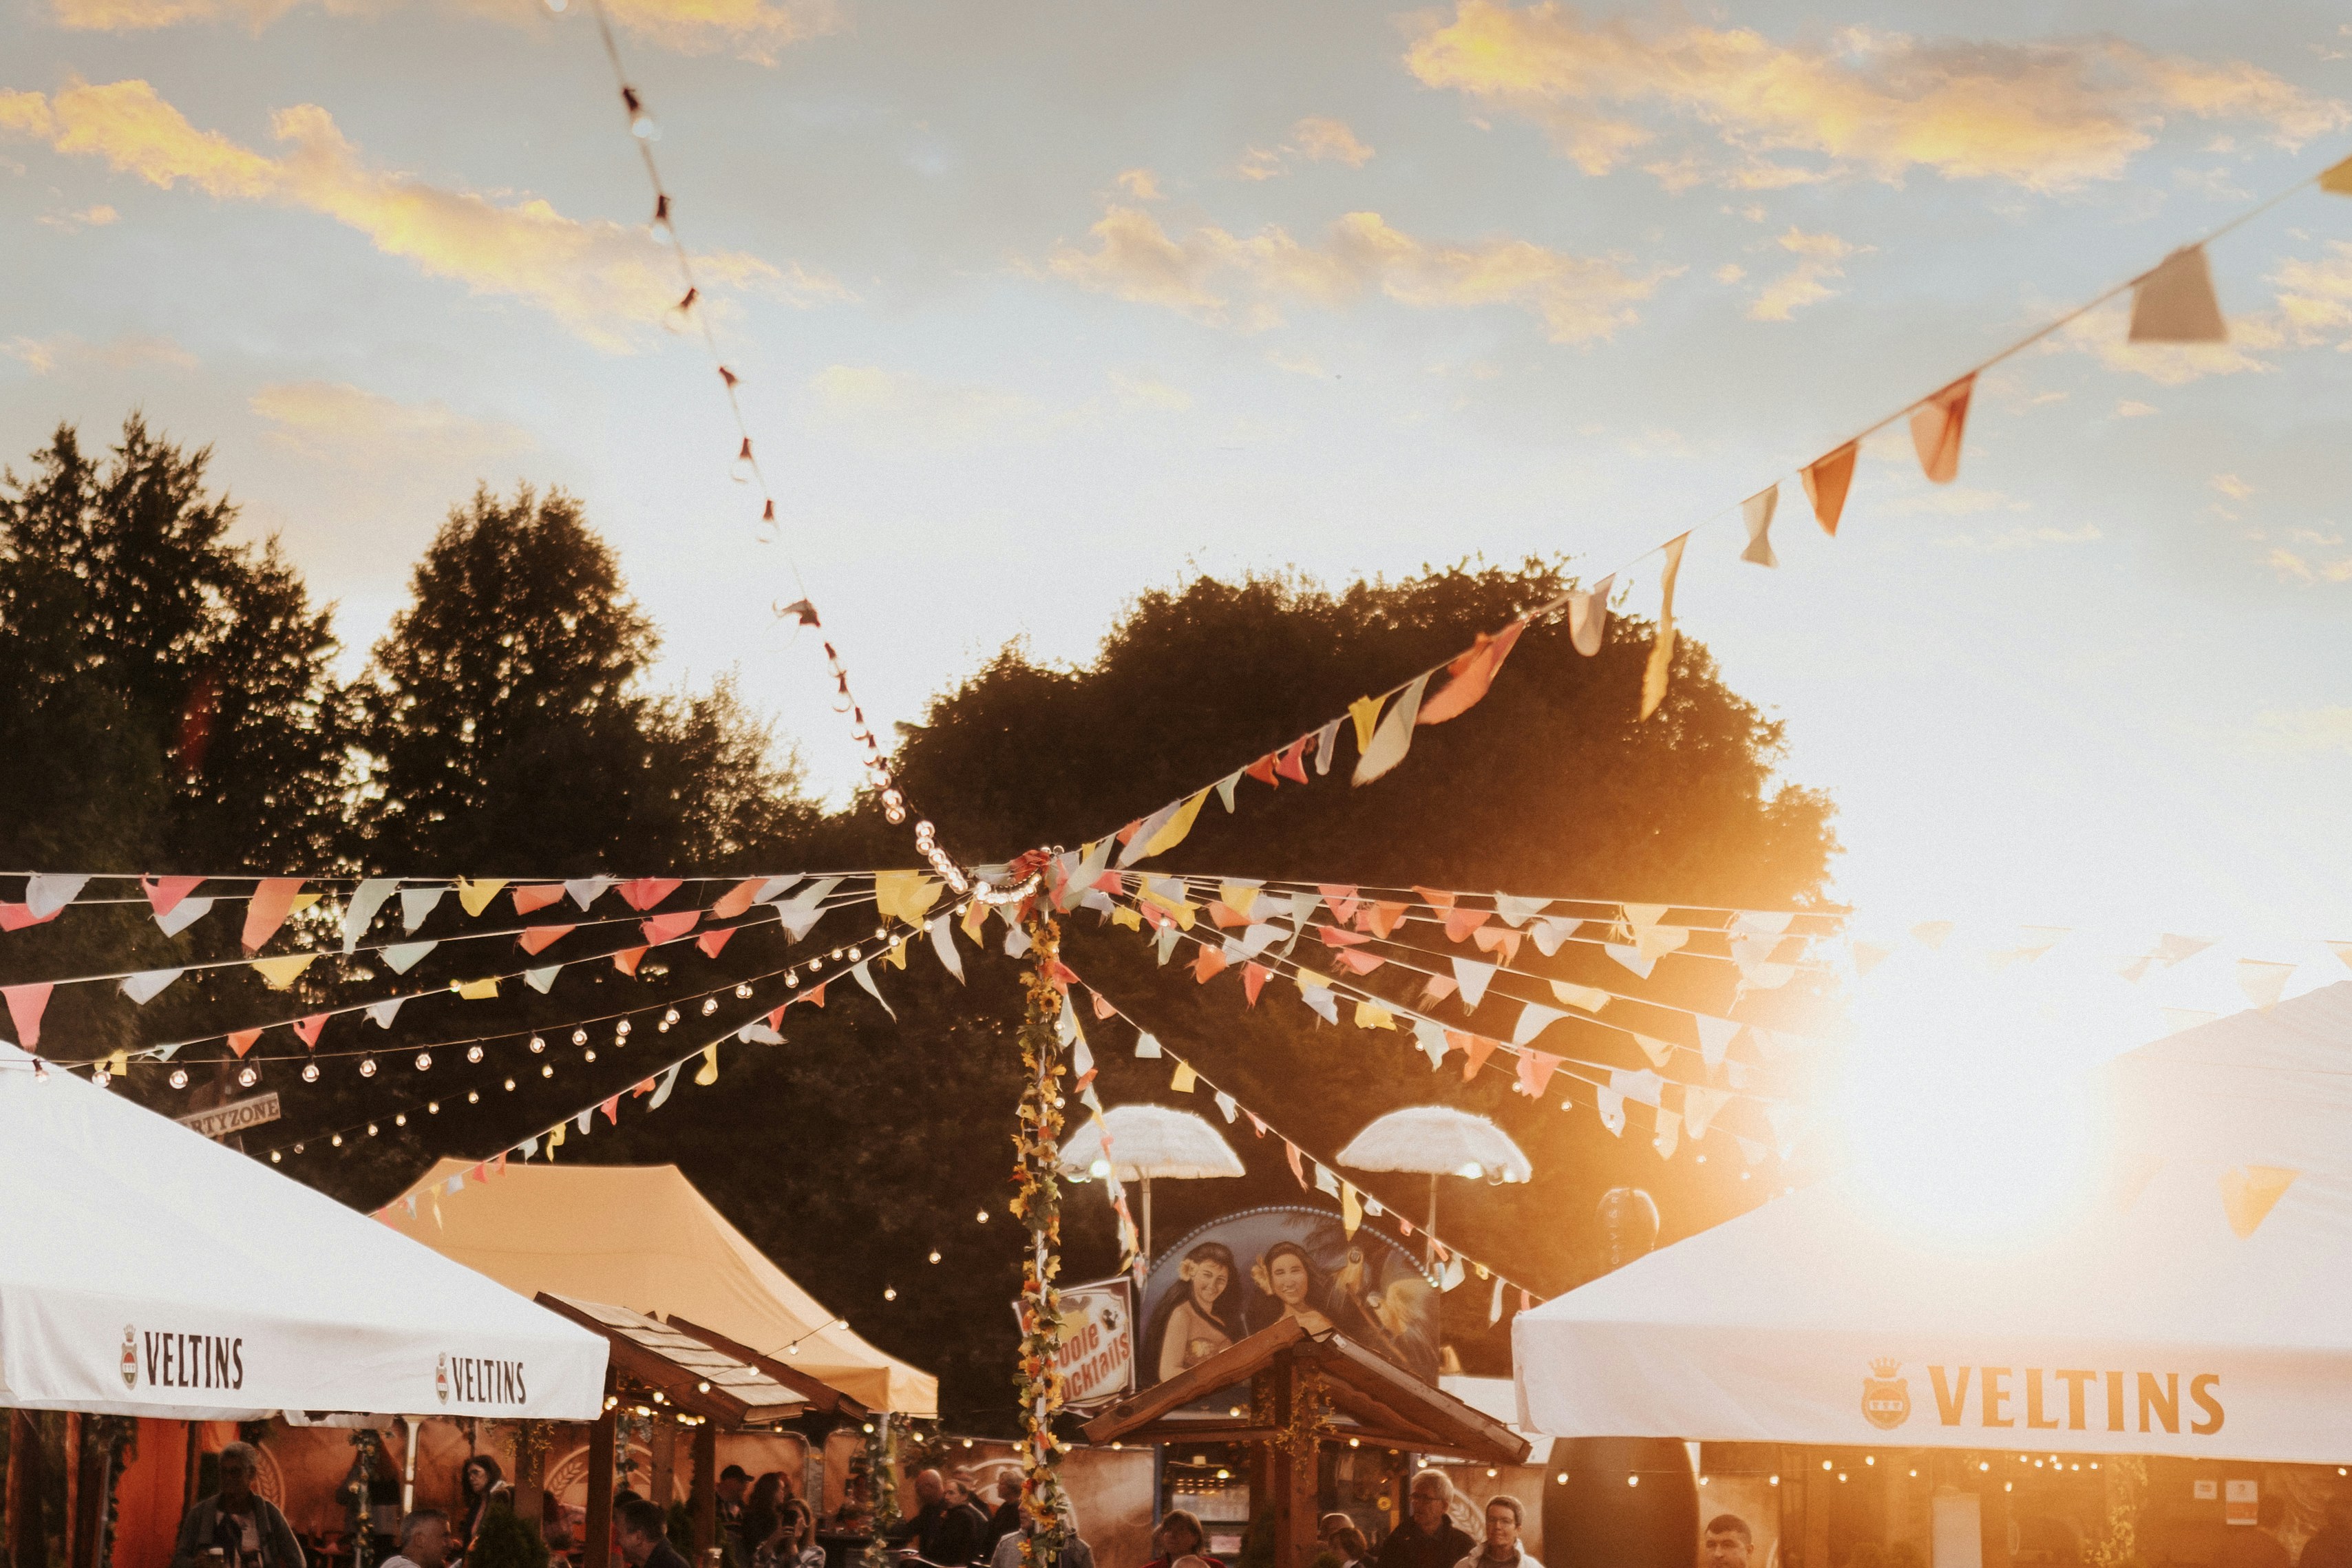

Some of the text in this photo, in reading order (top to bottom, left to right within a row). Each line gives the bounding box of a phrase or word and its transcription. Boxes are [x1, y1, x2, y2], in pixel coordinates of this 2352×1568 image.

[184, 1098, 279, 1134] RTYZONE
[144, 1331, 243, 1390] VELTINS
[1055, 1323, 1099, 1368] oole
[1061, 1332, 1131, 1403] ocktails
[452, 1357, 527, 1405] VELTINS
[1927, 1365, 2225, 1436] VELTINS
